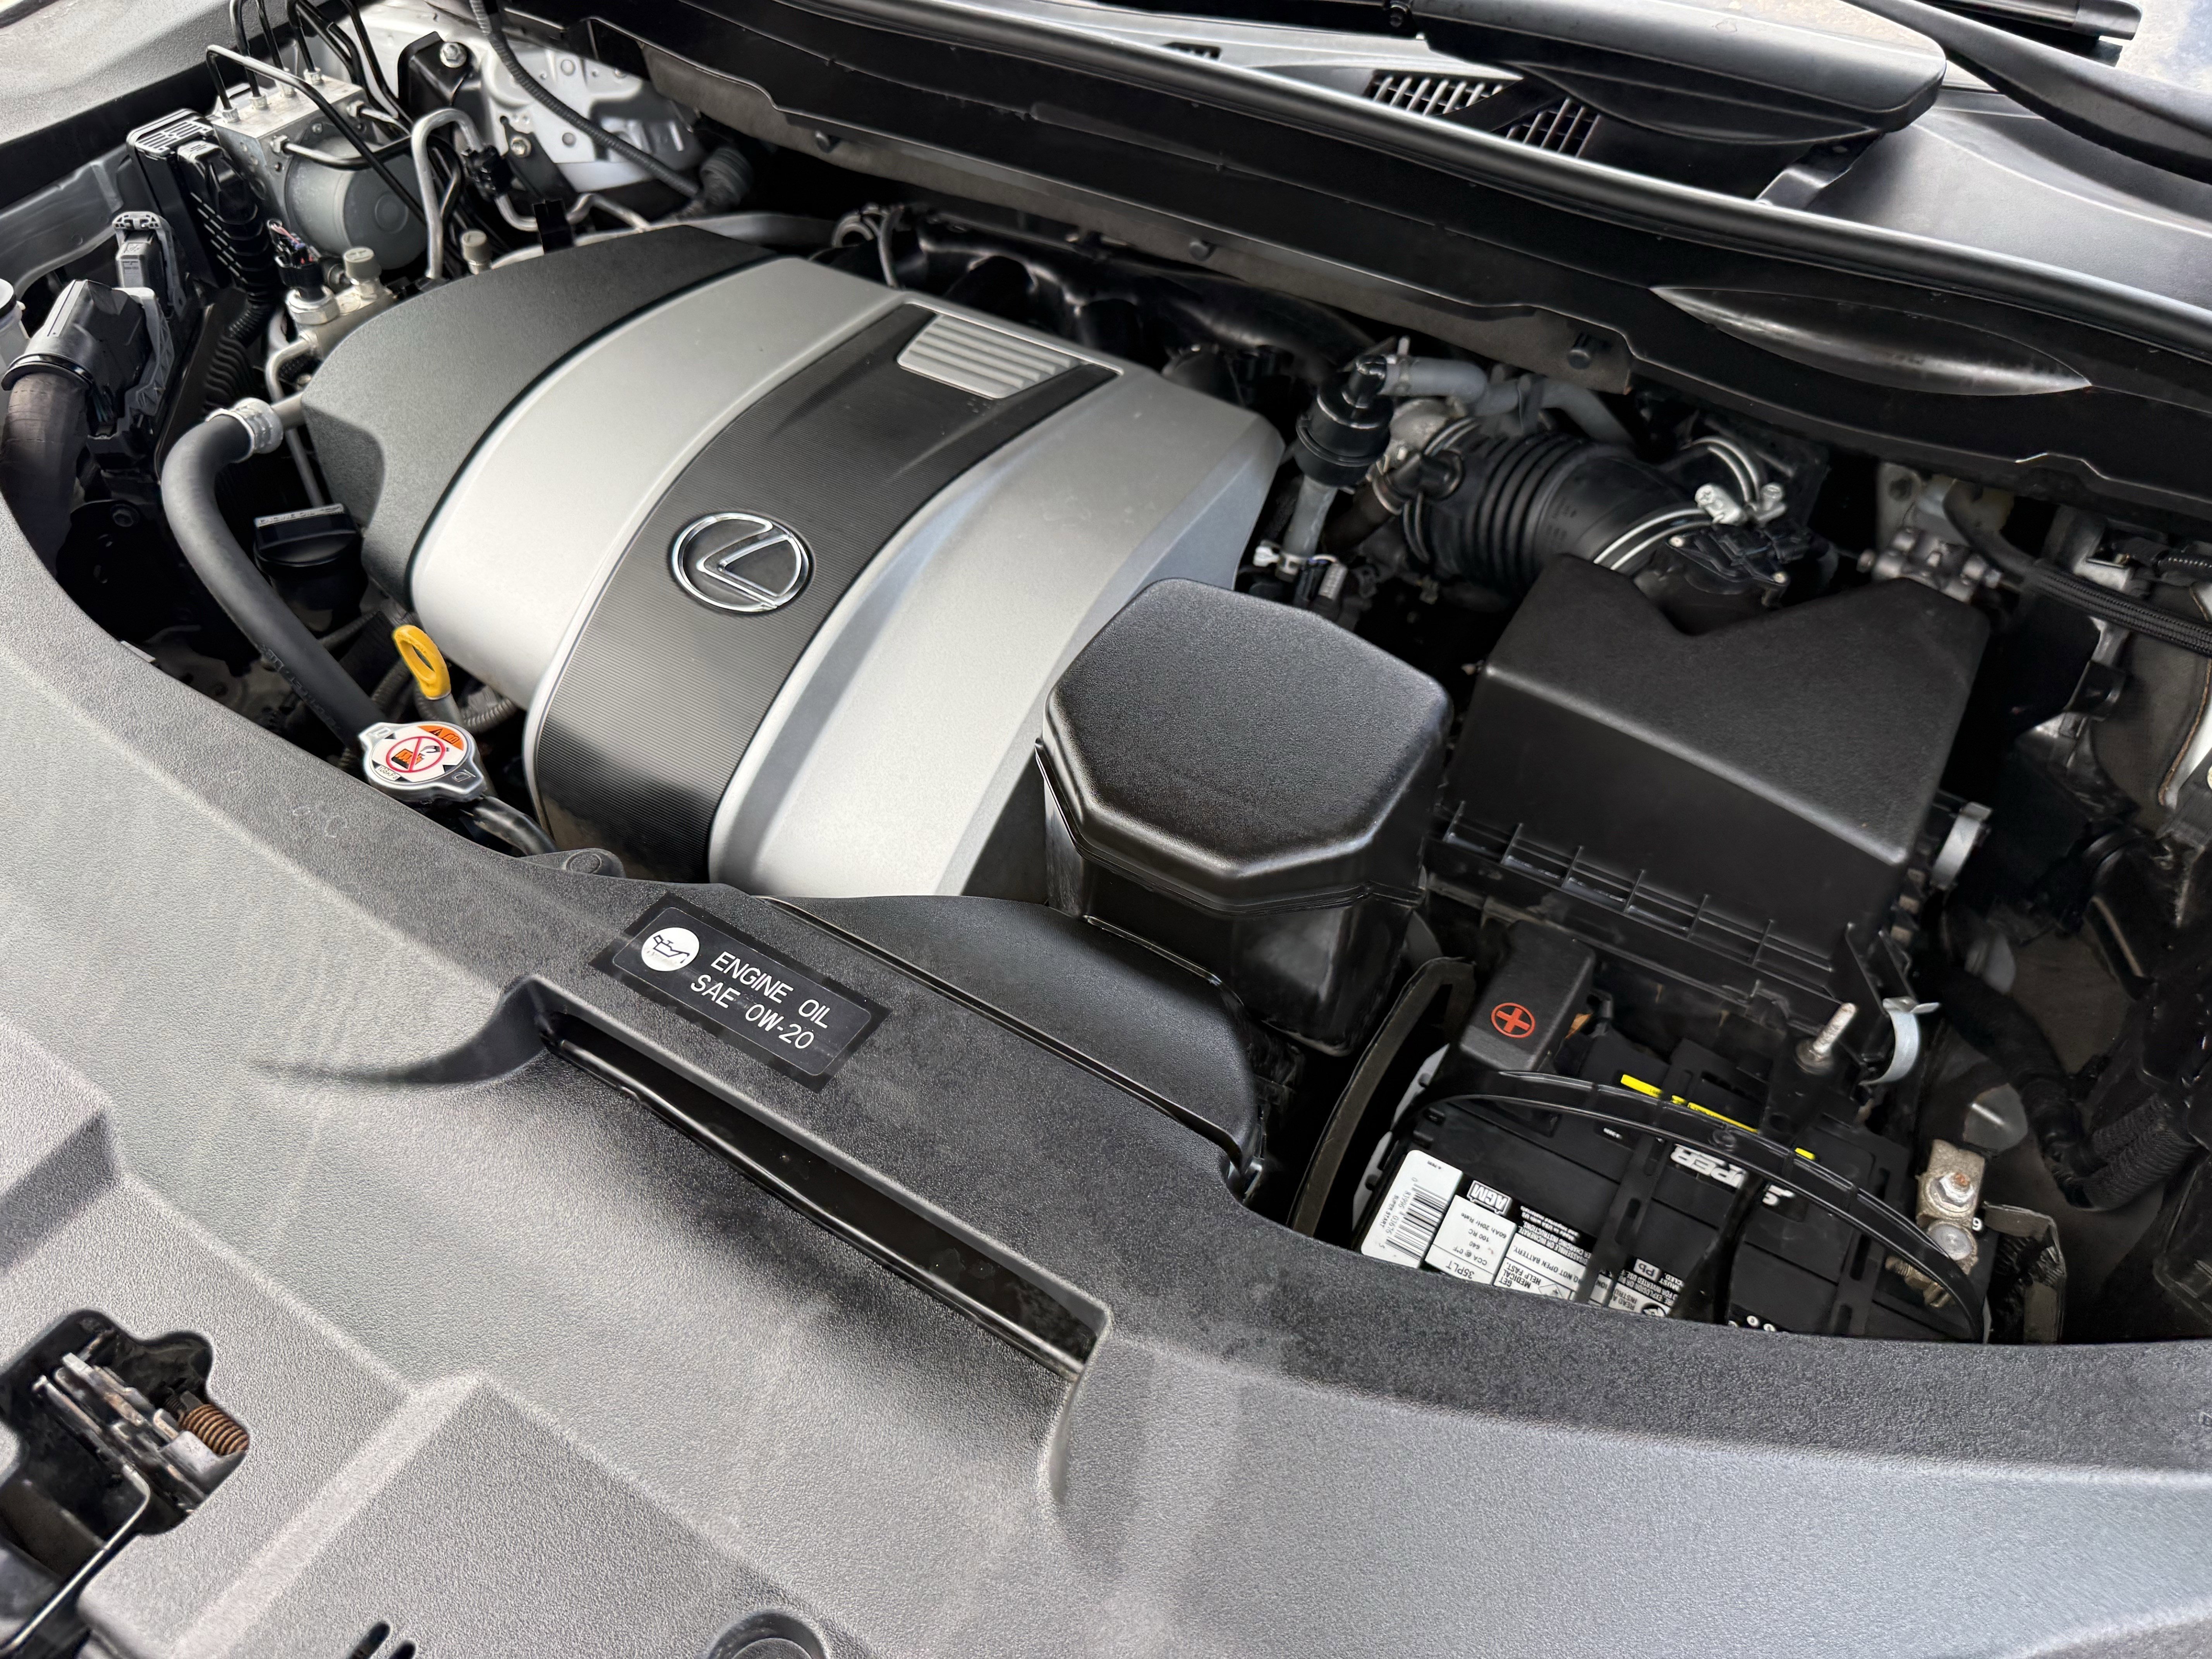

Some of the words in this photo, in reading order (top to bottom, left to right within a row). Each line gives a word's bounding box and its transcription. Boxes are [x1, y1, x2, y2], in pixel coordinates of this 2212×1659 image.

[711, 951, 793, 1004] ENGINE
[798, 999, 830, 1029] OIL
[691, 974, 740, 1008] SAE
[745, 1004, 815, 1049] 0W-20
[1388, 1195, 1399, 1211] SUPER
[1470, 1184, 1507, 1210] AGM
[1379, 1211, 1390, 1228] START
[1460, 1212, 1474, 1223] Rate
[1479, 1234, 1489, 1242] 100
[1469, 1241, 1480, 1249] 640
[1473, 1255, 1487, 1266] CCA
[1541, 1260, 1558, 1273] OPEN
[1446, 1260, 1475, 1279] 35PLT
[1505, 1262, 1523, 1276] FAST.
[1559, 1269, 1572, 1280] NOT
[1637, 1262, 1656, 1277] Pb
[1498, 1276, 1512, 1287] GET
[1502, 1269, 1531, 1288] MEDICAL
[1524, 1273, 1541, 1285] HELP
[1618, 1298, 1635, 1310] READ
